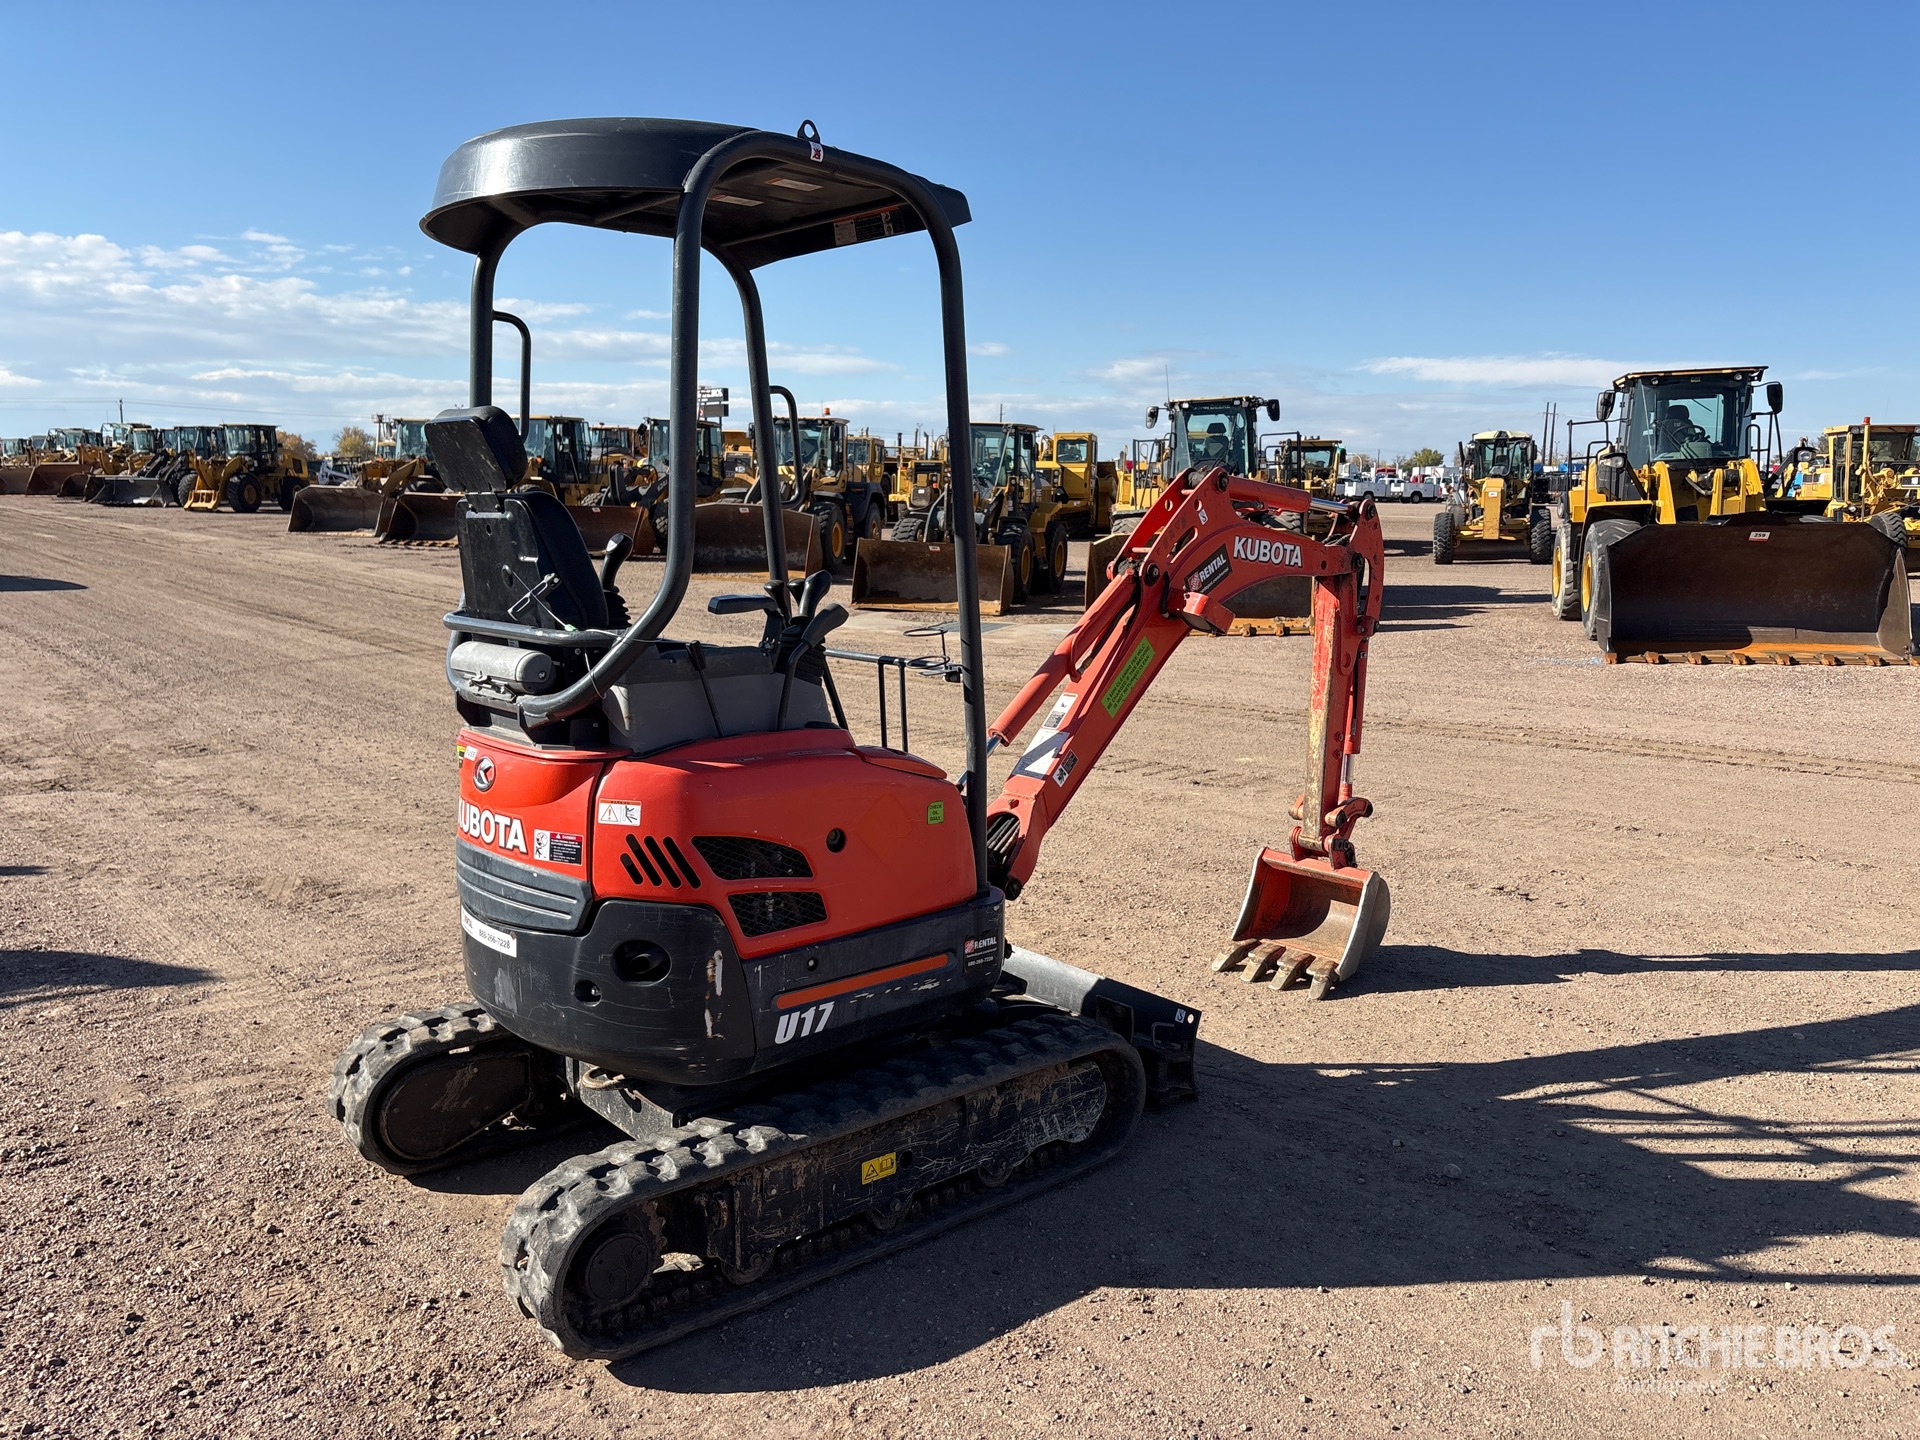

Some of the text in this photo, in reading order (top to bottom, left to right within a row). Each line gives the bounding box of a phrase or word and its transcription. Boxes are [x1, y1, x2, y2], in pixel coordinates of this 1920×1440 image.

[1233, 535, 1302, 567] KUBOTA
[1199, 553, 1227, 583] RENTAL
[975, 936, 997, 949] RENTAL
[775, 1001, 835, 1045] U17
